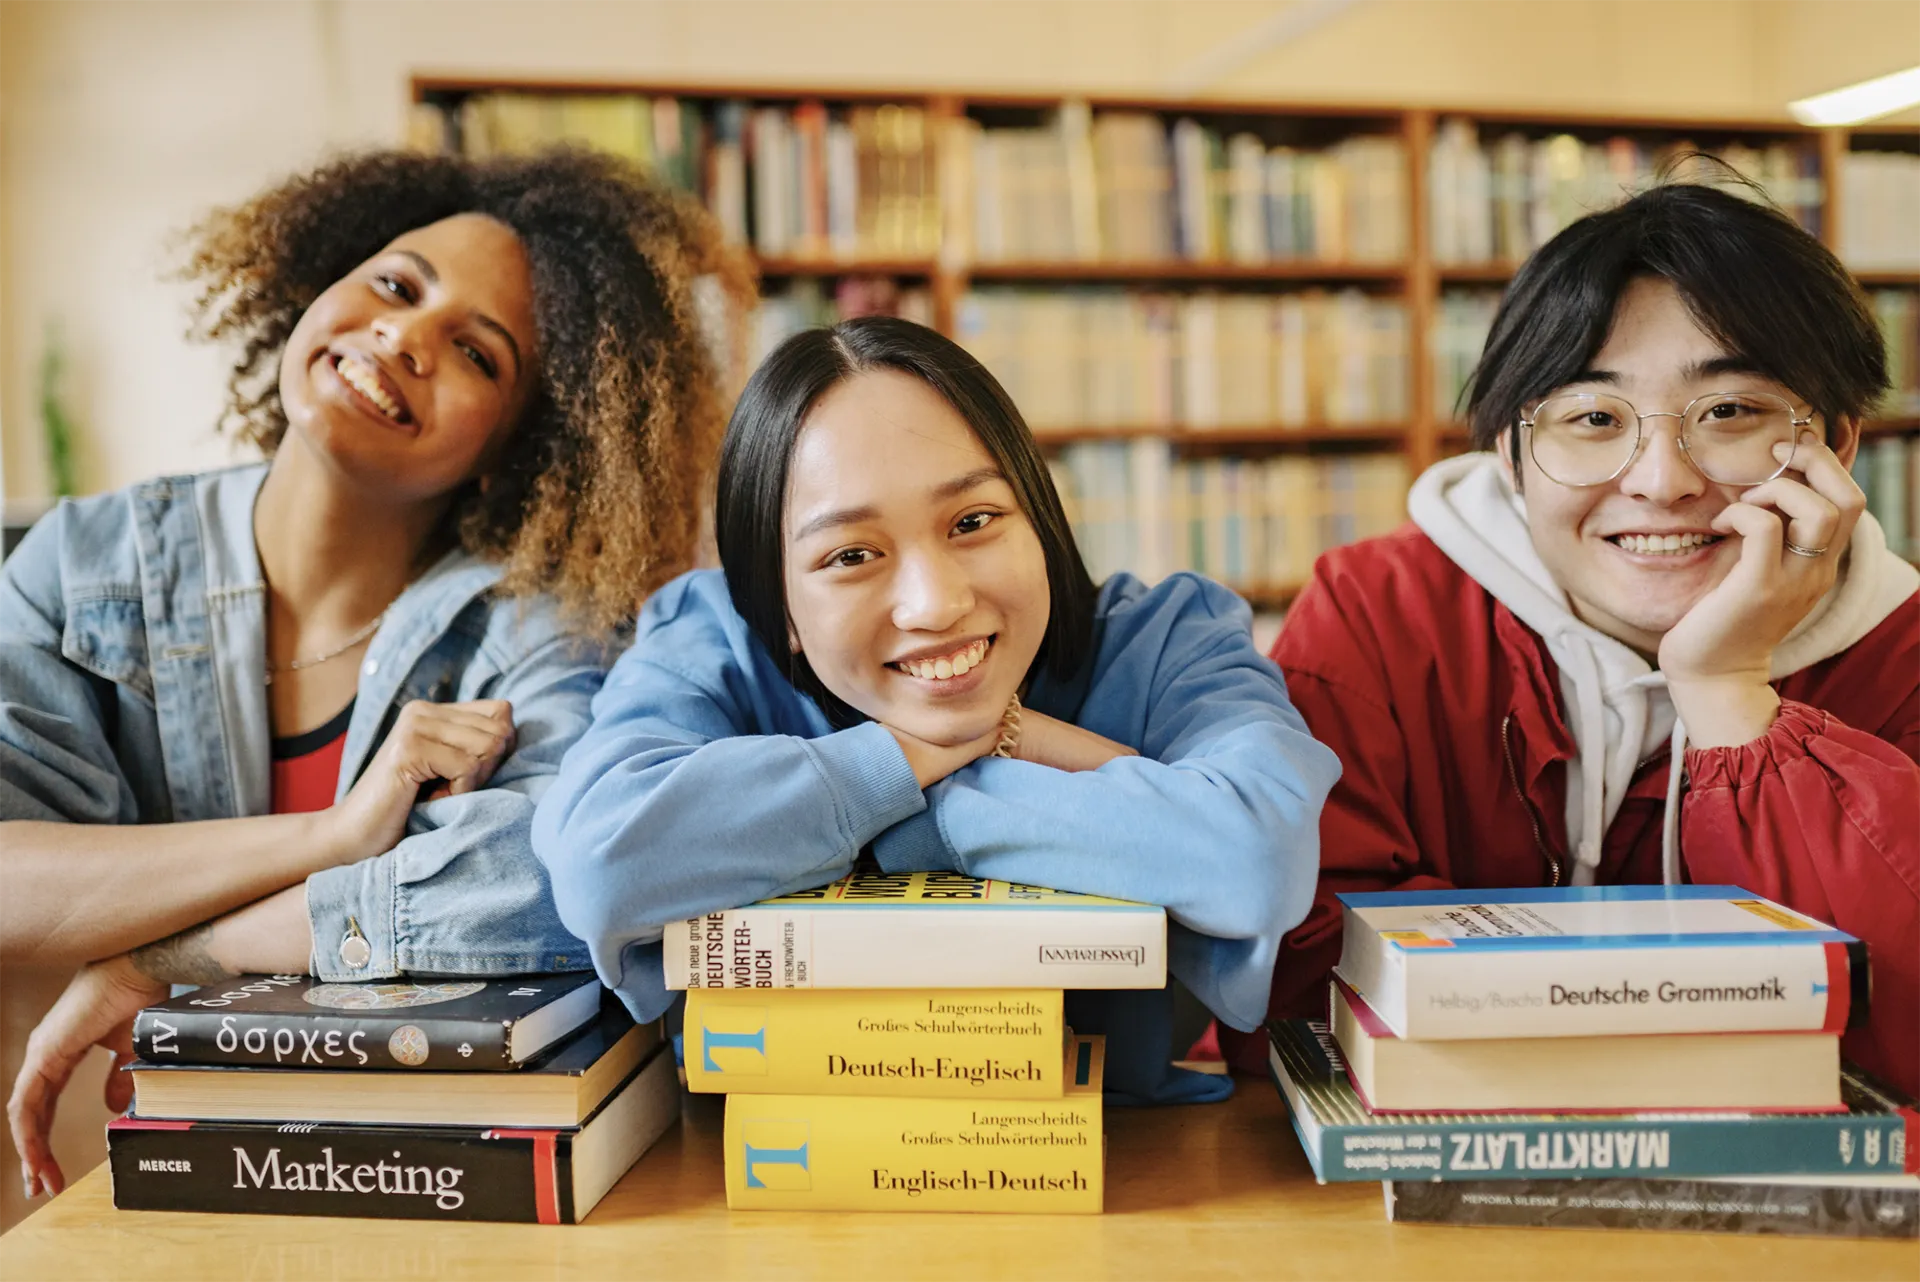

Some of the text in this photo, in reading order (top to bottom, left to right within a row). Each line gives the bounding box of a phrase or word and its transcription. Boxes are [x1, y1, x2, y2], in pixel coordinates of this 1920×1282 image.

[687, 918, 702, 941] groß
[689, 945, 700, 969] neue
[707, 912, 724, 989] DEUTSCHE
[729, 920, 751, 989] WÖRTER-
[755, 949, 772, 989] BUCH
[797, 961, 807, 982] BUCH
[1550, 981, 1650, 1006] Deutsche
[1657, 976, 1787, 1004] Grammatik
[928, 999, 1043, 1018] Langenscheidts
[857, 1017, 1043, 1037] Großes Schulwörterbuch
[827, 1055, 1043, 1086] Deutsch-Englisch
[971, 1112, 1087, 1130] Langenscheidts
[901, 1131, 1087, 1147] Großes Schulwörterbuch
[1449, 1131, 1670, 1171] MARKTPLATZ
[138, 1159, 192, 1173] MERCER
[232, 1147, 466, 1210] Marketing
[872, 1169, 1088, 1198] Englisch-Deutsch
